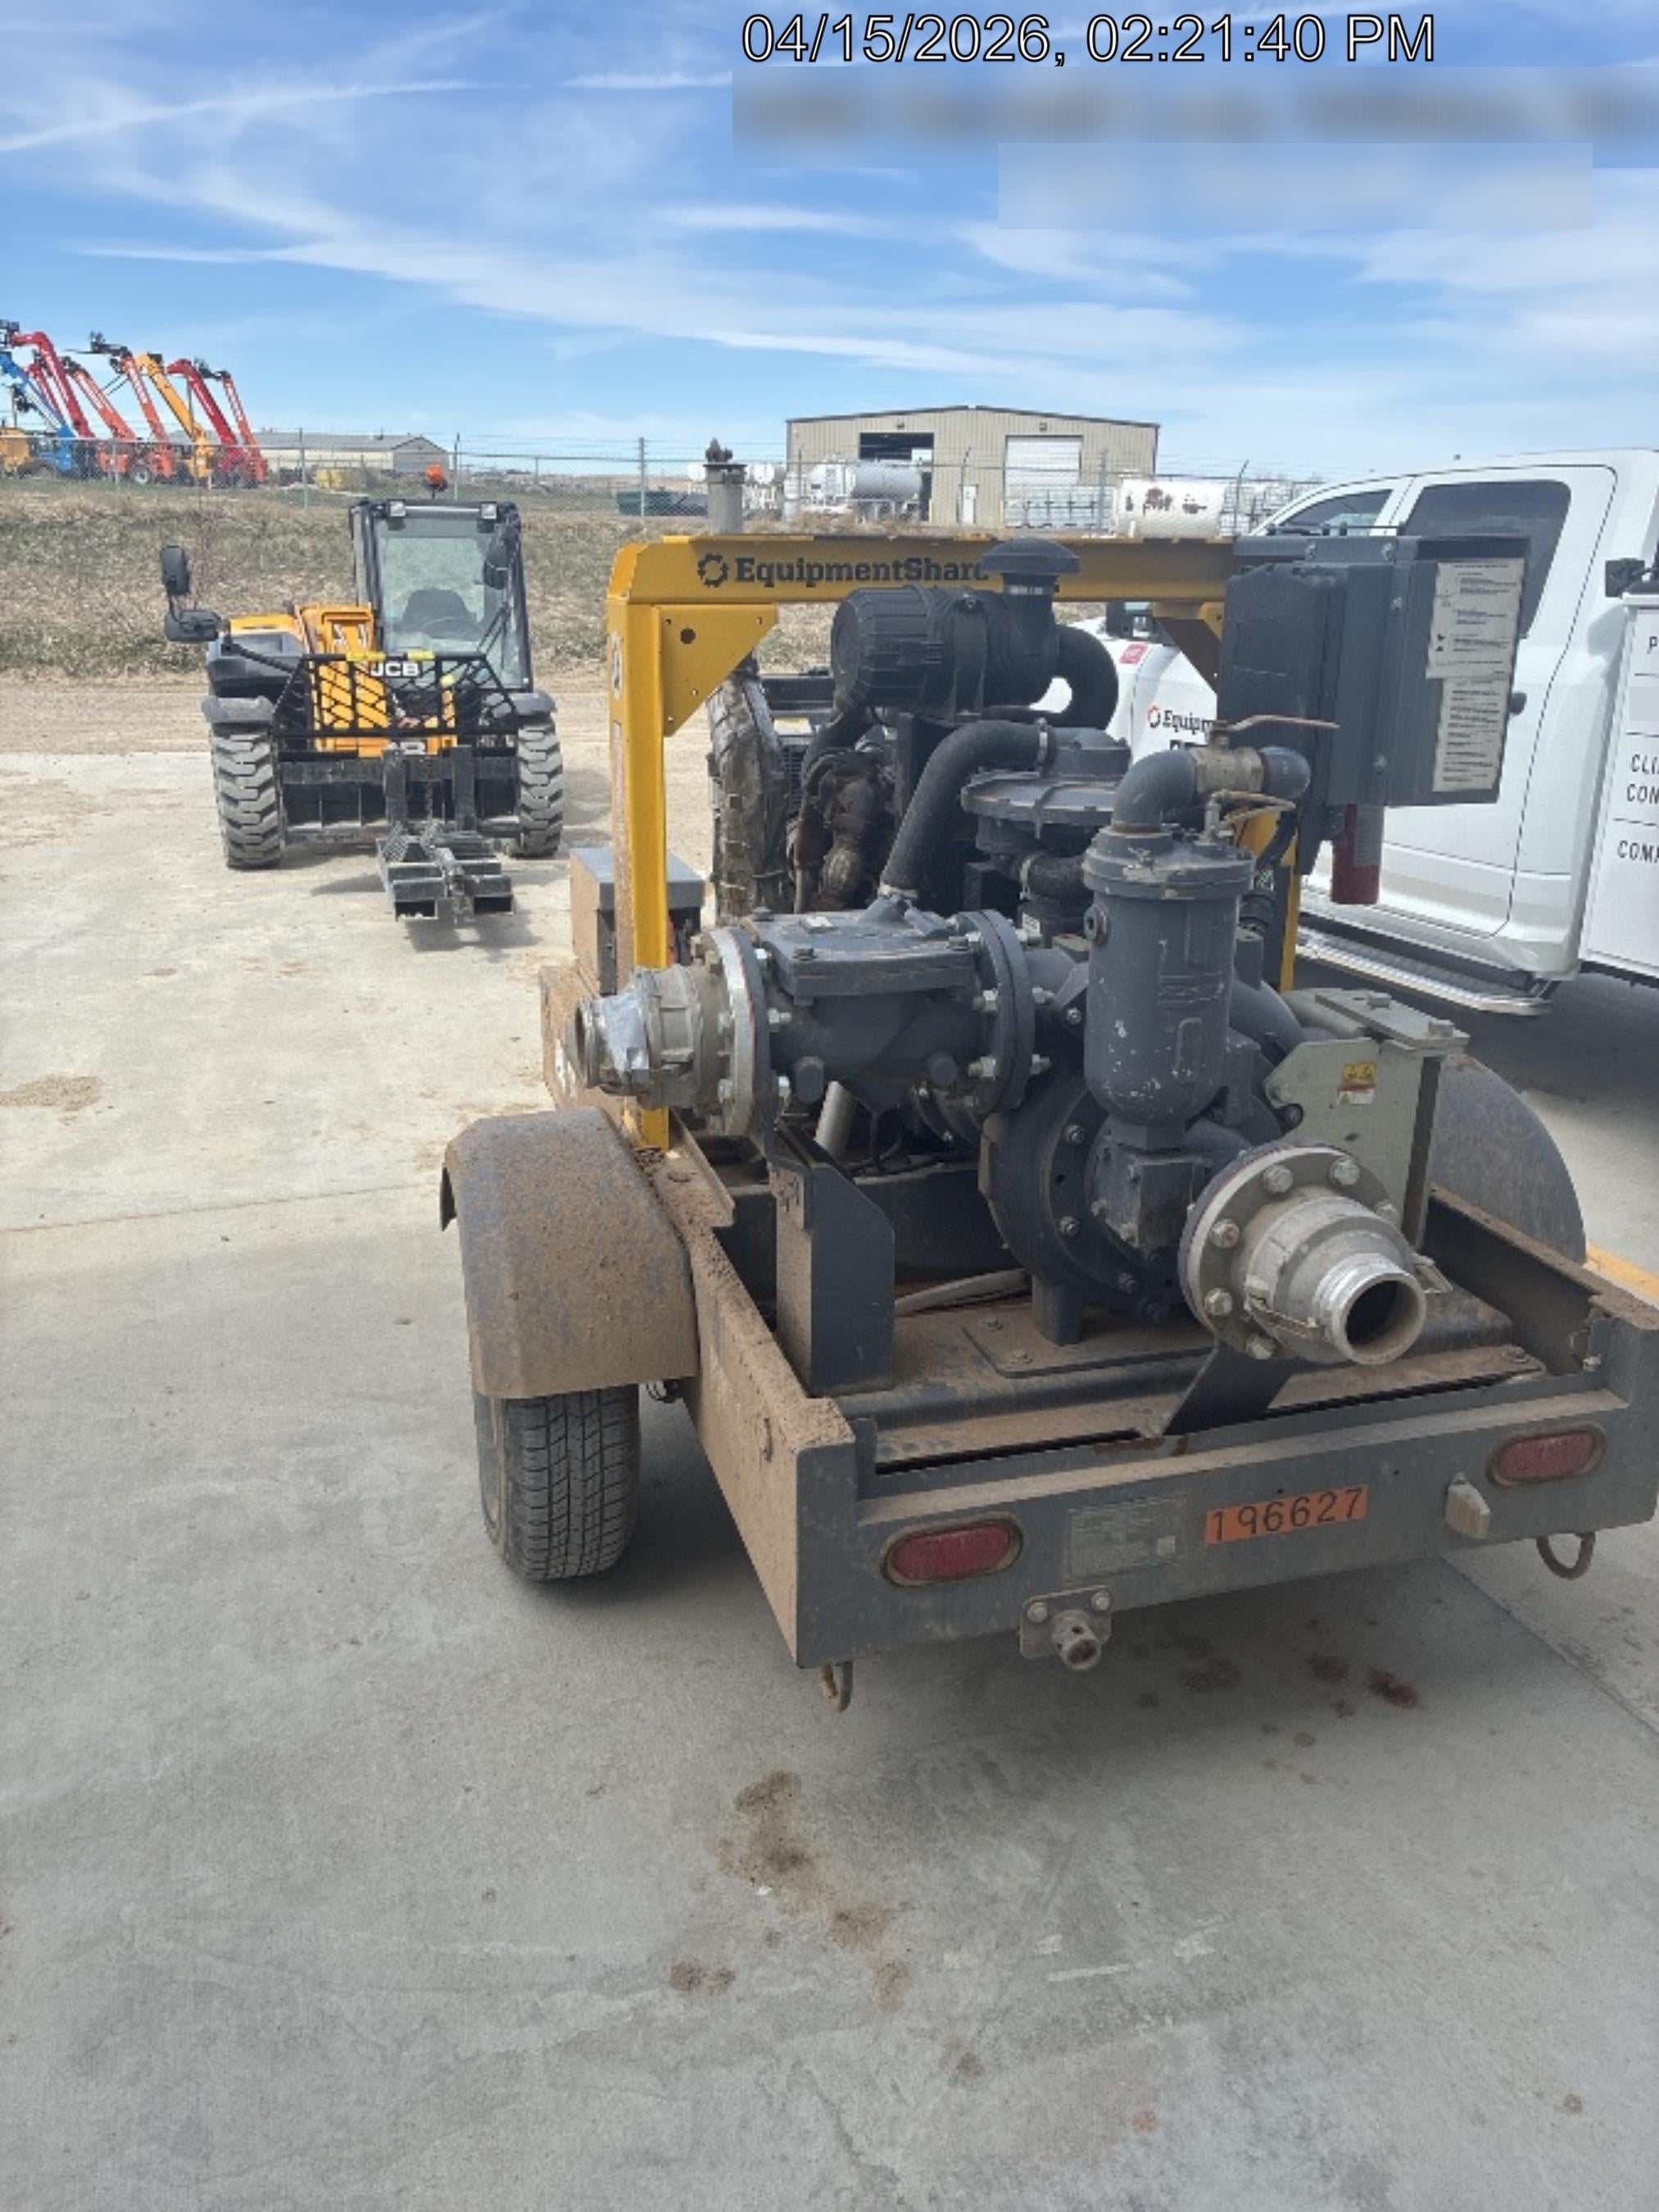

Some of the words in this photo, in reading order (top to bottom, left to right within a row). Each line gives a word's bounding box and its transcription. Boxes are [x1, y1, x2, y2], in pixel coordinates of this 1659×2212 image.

[370, 660, 419, 677] JCB
[1631, 754, 1659, 774] CLI
[1211, 1485, 1363, 1542] 196627
